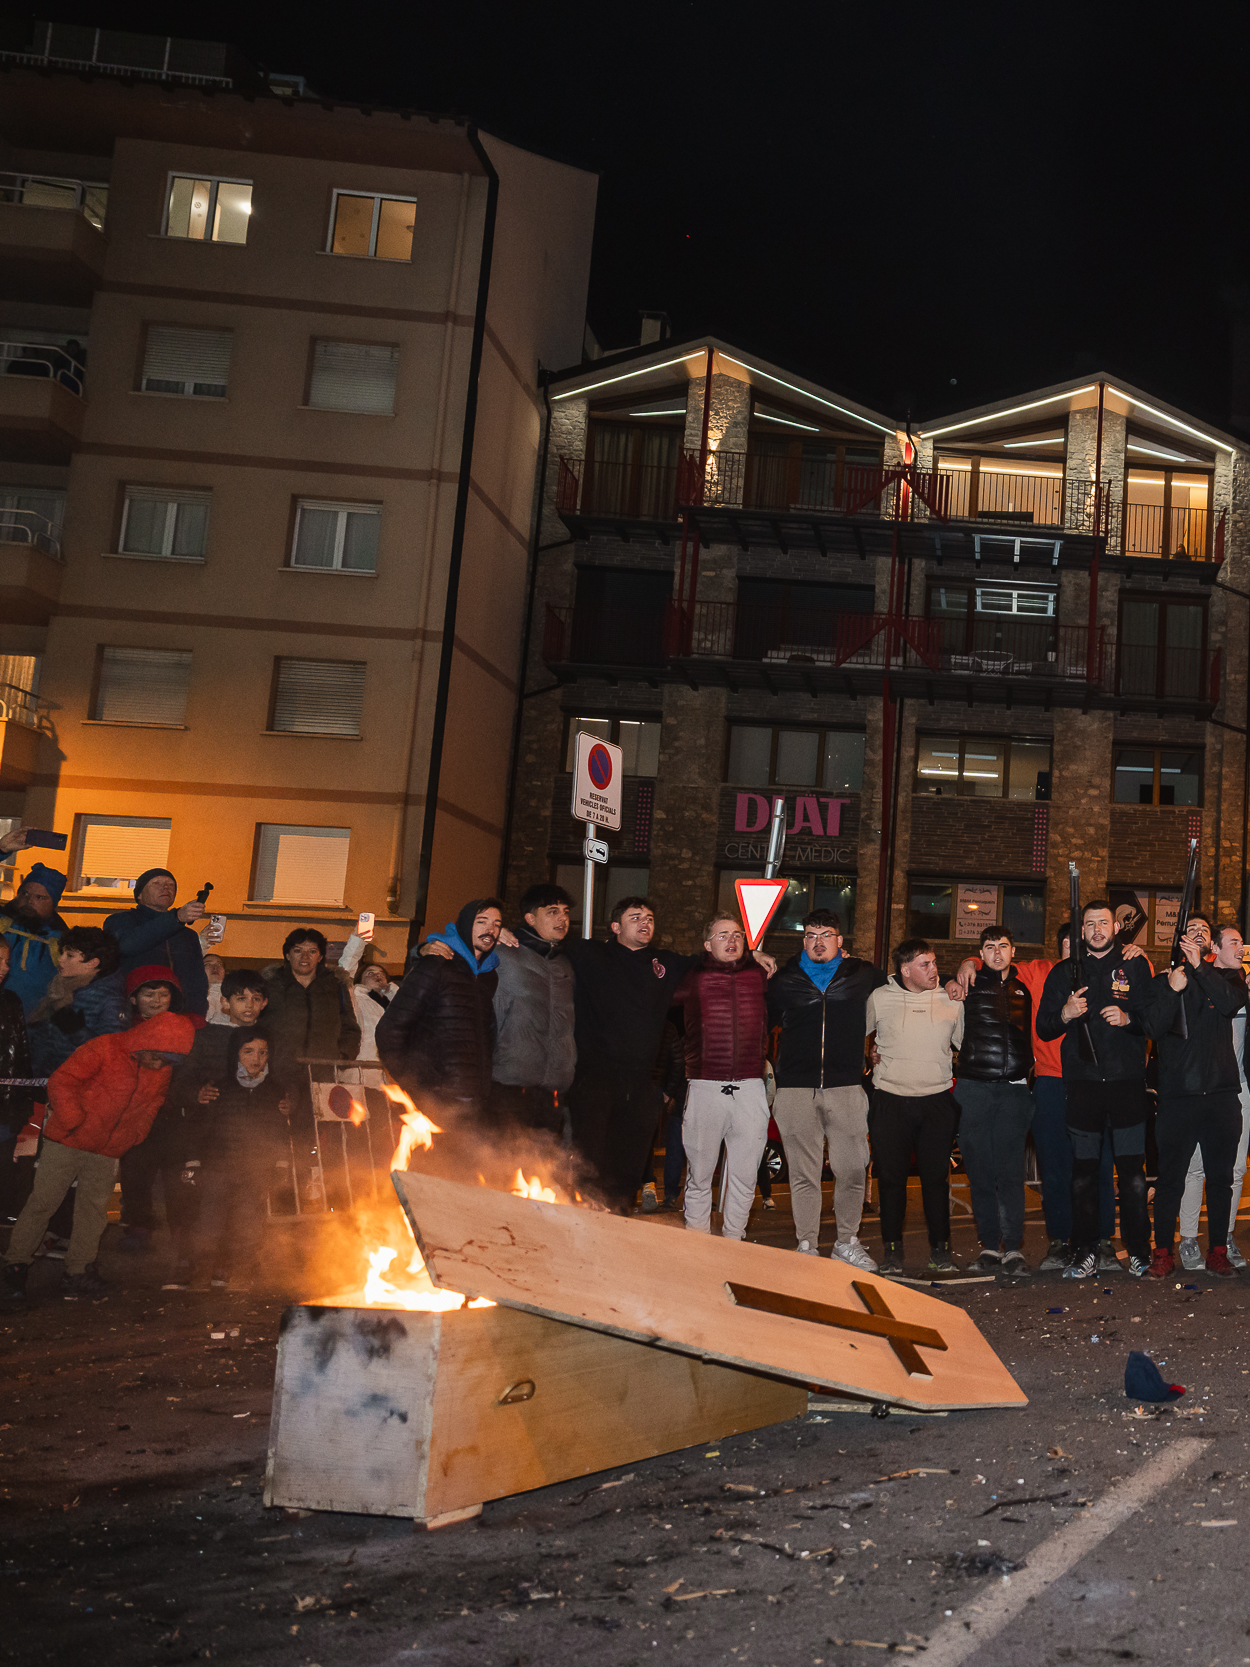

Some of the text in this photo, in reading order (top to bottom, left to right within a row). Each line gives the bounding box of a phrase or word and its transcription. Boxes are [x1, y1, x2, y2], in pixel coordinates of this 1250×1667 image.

[589, 792, 608, 804] RESERVAT
[580, 798, 616, 816] VEHICLES OFICIALS
[586, 810, 592, 818] DE
[795, 843, 851, 863] MÈDIC
